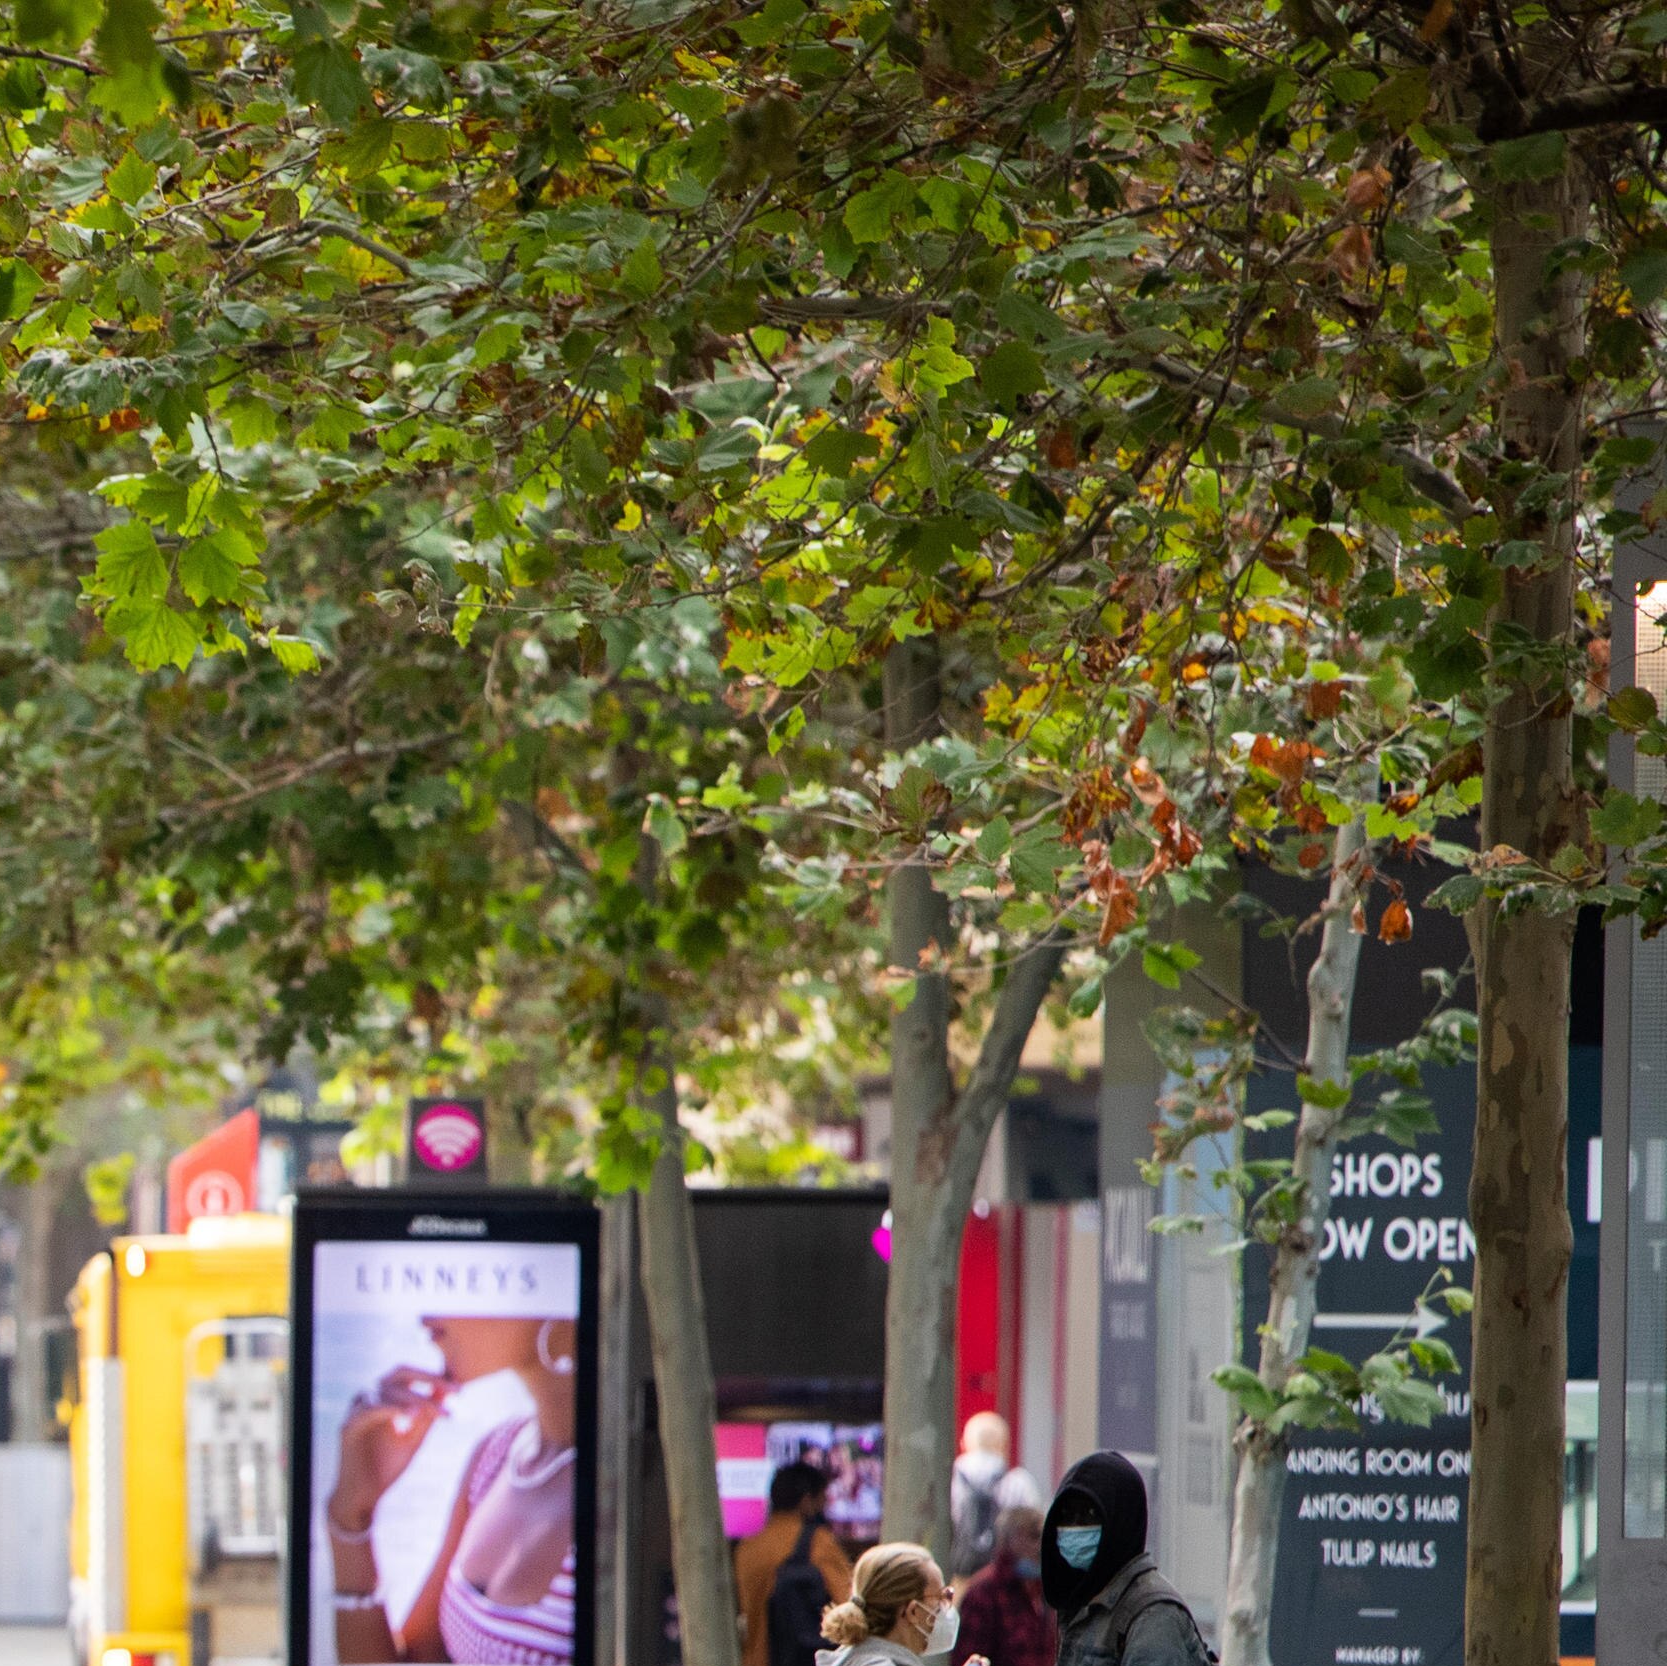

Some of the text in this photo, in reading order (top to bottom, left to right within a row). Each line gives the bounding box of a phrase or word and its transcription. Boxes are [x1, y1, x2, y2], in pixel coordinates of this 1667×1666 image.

[1329, 1152, 1444, 1198] SHOPS
[355, 1263, 539, 1294] LINNEYS
[1286, 1448, 1472, 1478] ANDING ROOM ON
[1298, 1493, 1461, 1523] ANTONIO'S HAIR
[1320, 1538, 1438, 1569] TULIP NAILS
